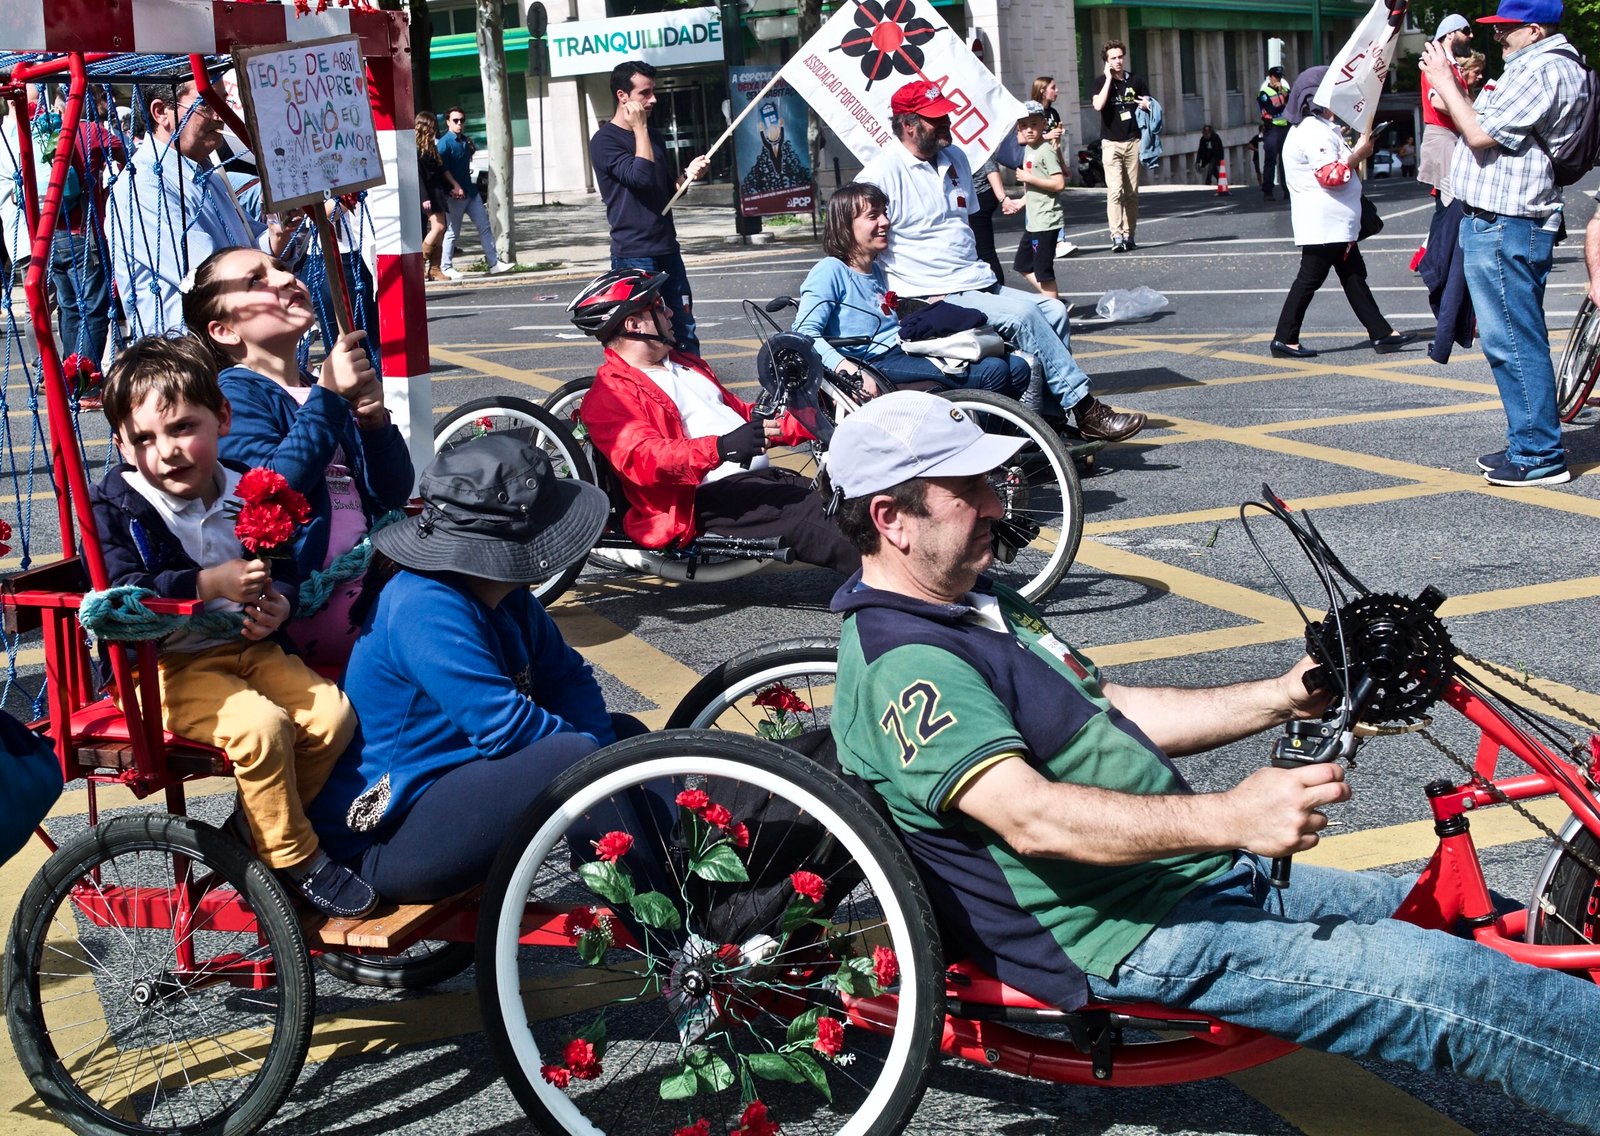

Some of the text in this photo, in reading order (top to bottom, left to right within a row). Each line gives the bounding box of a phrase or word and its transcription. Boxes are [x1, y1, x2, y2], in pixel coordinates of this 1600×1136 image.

[553, 22, 721, 57] TRANQUILIDADE
[277, 53, 297, 74] 25
[305, 53, 329, 75] DE
[837, 81, 882, 137] PORTUGUESA
[876, 131, 893, 148] DE
[793, 196, 811, 207] PCP
[879, 679, 958, 768] 12
